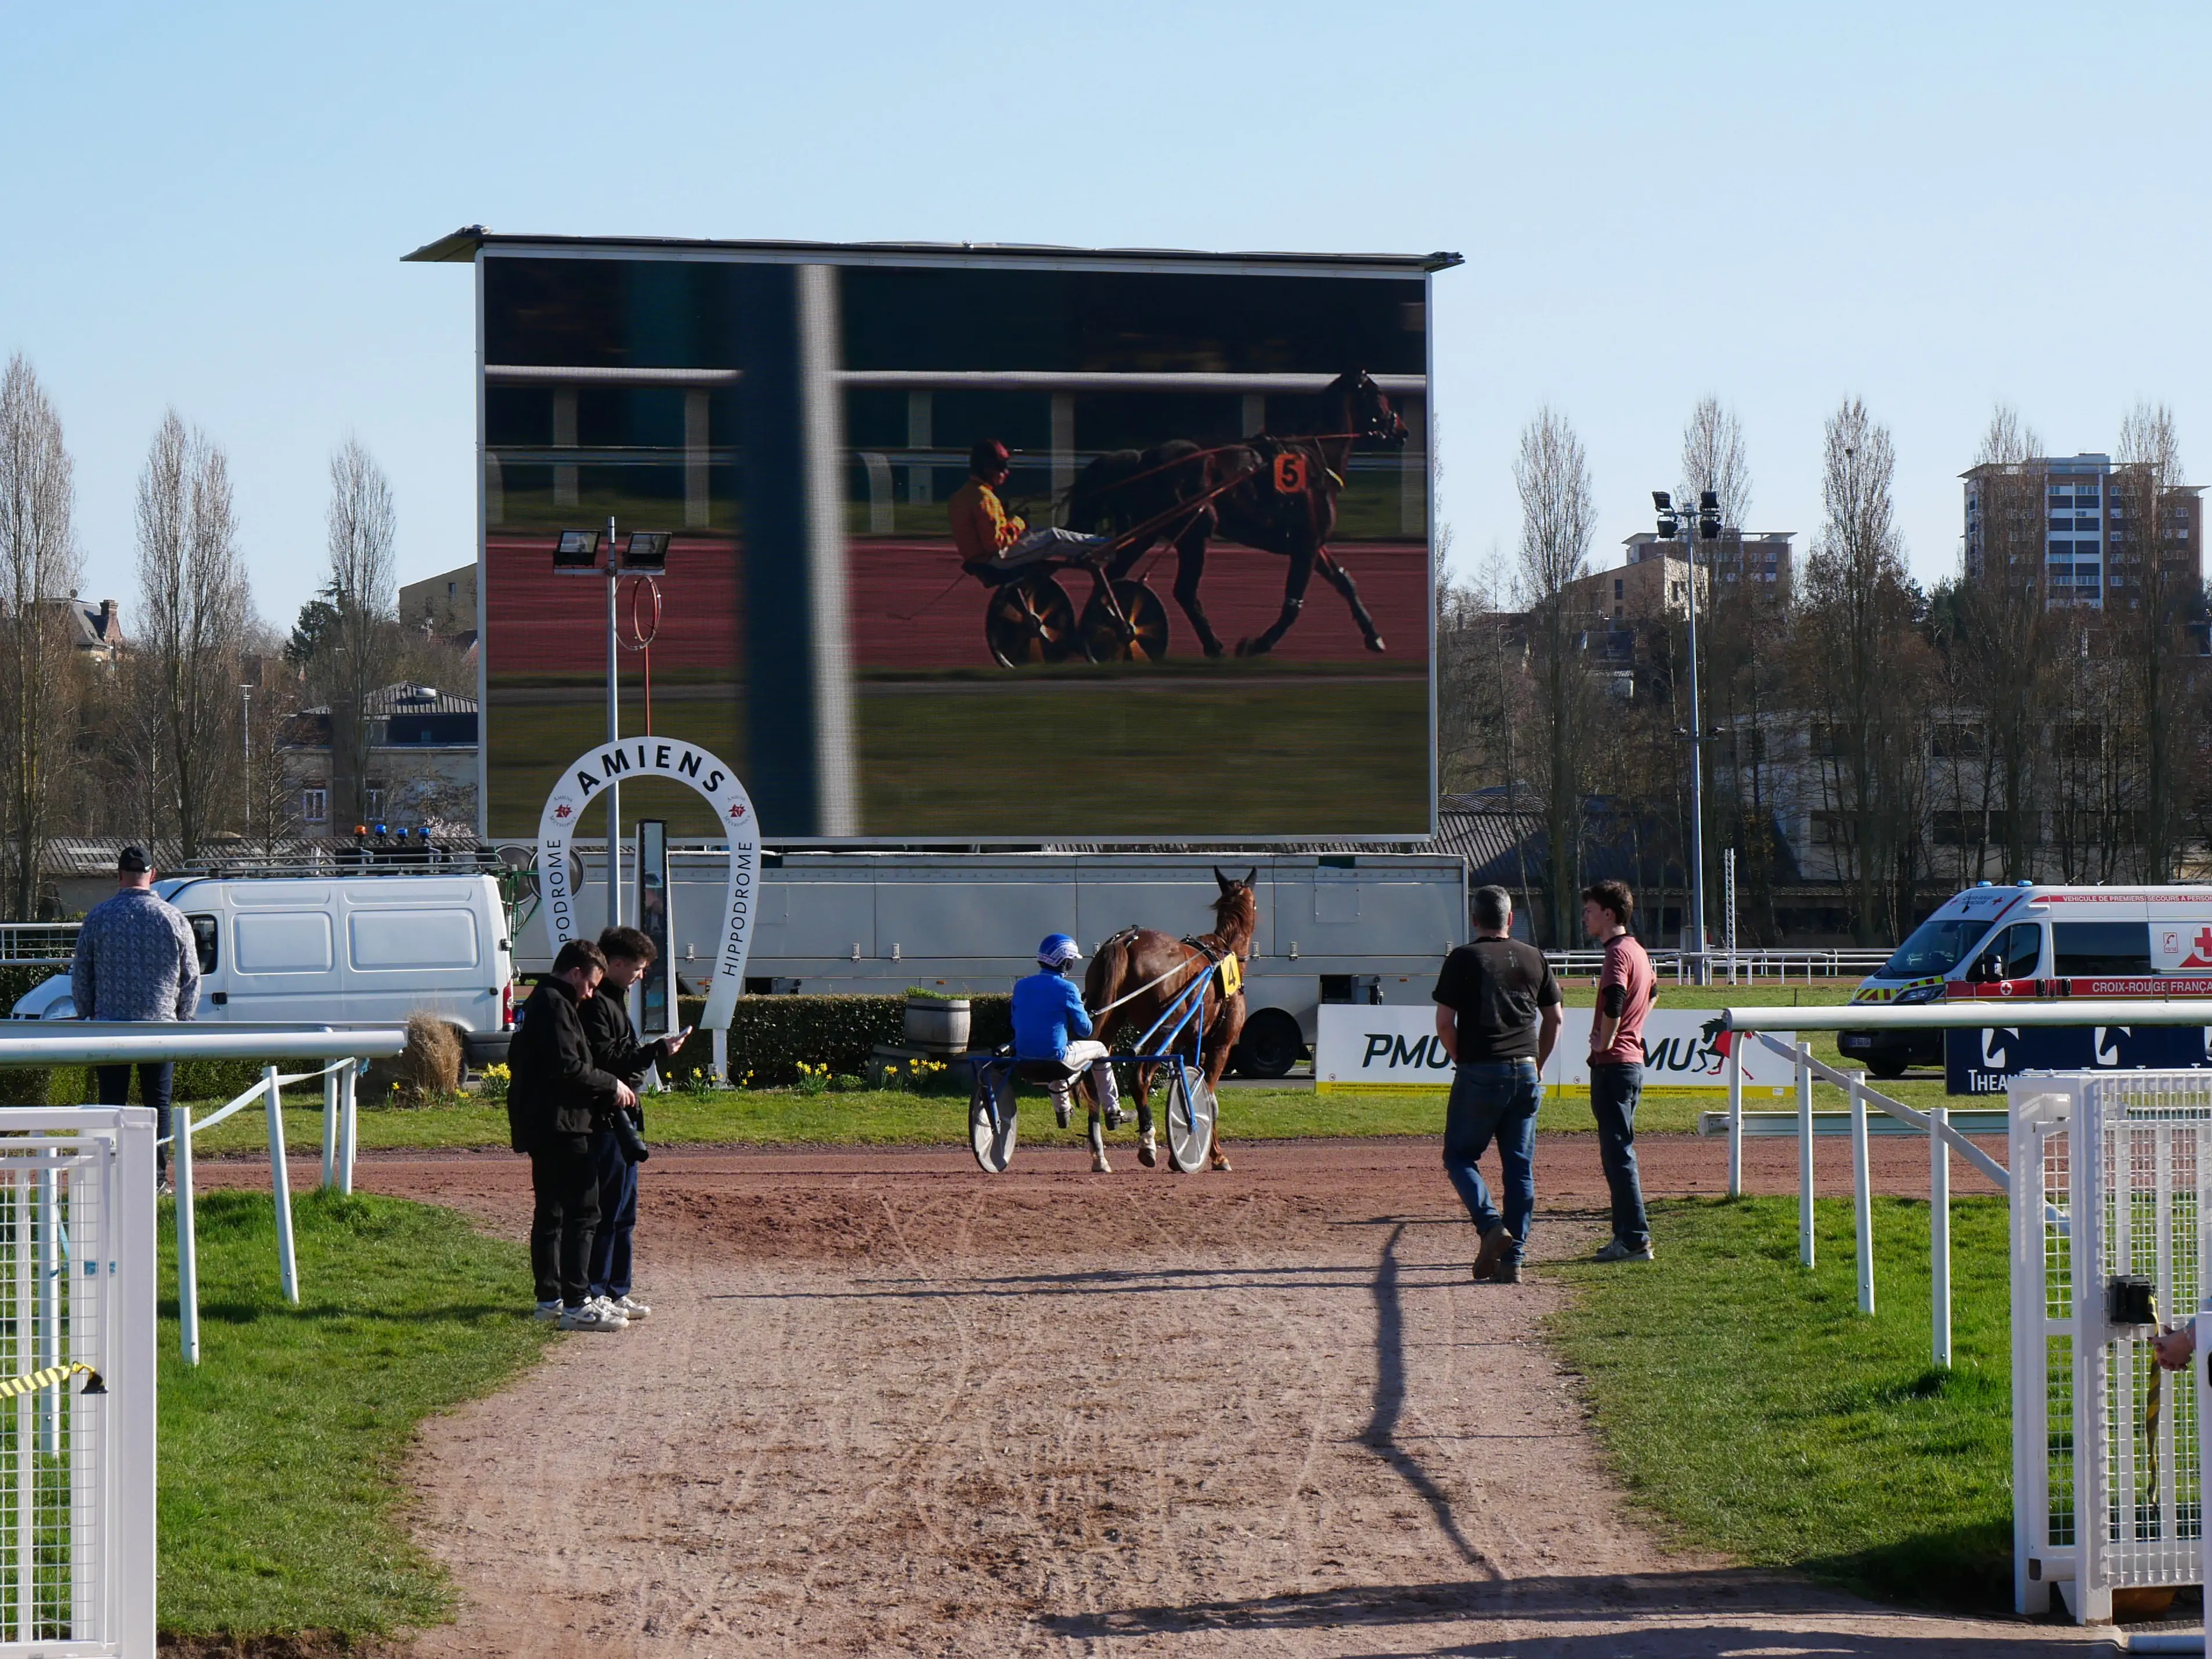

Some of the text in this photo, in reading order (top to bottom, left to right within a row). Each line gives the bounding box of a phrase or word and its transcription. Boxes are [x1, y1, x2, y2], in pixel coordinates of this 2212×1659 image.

[1282, 460, 1298, 487] 5
[577, 745, 725, 796] AMIENS
[547, 840, 573, 943] PODROME
[722, 842, 752, 977] HIPPODROME
[1228, 960, 1236, 986] 4
[2092, 981, 2167, 992] CROIX-ROUGE
[1362, 1033, 1452, 1069] PMU
[1640, 1038, 1697, 1071] MU
[1967, 1069, 2018, 1091] THEA
